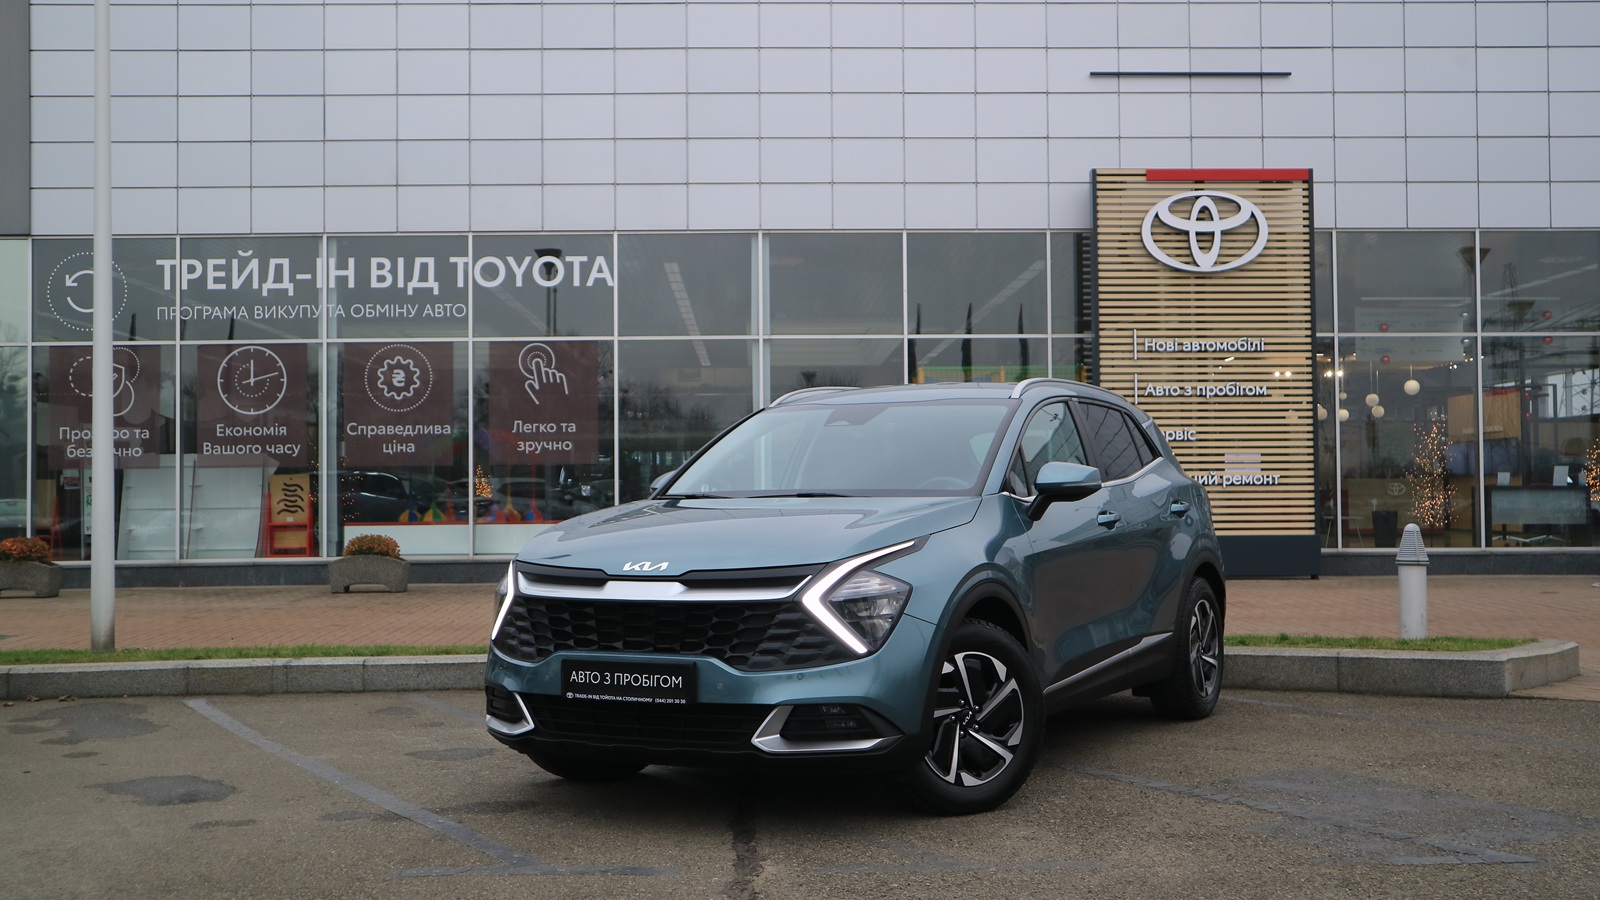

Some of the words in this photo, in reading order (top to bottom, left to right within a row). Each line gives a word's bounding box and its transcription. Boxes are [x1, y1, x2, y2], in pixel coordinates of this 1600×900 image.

[155, 250, 355, 296] ТРЕЙД-ІН
[370, 257, 439, 295] ВІД
[449, 255, 614, 288] TOYOTA
[157, 306, 249, 320] ПРОГРАМА
[254, 305, 322, 319] ВИКУПУ
[327, 304, 346, 318] ТА
[350, 304, 418, 317] ОБМІНУ
[422, 303, 467, 317] АВТО
[1144, 338, 1178, 352] Нові
[1182, 337, 1265, 352] автомобілі
[1144, 383, 1180, 396] Авто
[1184, 386, 1193, 396] з
[1196, 382, 1267, 399] пробігом
[134, 429, 150, 439] та
[216, 423, 287, 436] Економія
[346, 422, 451, 438] Справедлива
[511, 420, 557, 433] Легко
[560, 423, 576, 433] та
[203, 442, 262, 455] Вашого
[266, 443, 301, 457] часу
[382, 440, 415, 455] ціна
[516, 441, 572, 454] зручно
[1222, 474, 1280, 488] ремонт
[622, 561, 670, 572] KIA
[570, 671, 601, 684] АВТО
[614, 672, 683, 688] ПРОБІГОМ
